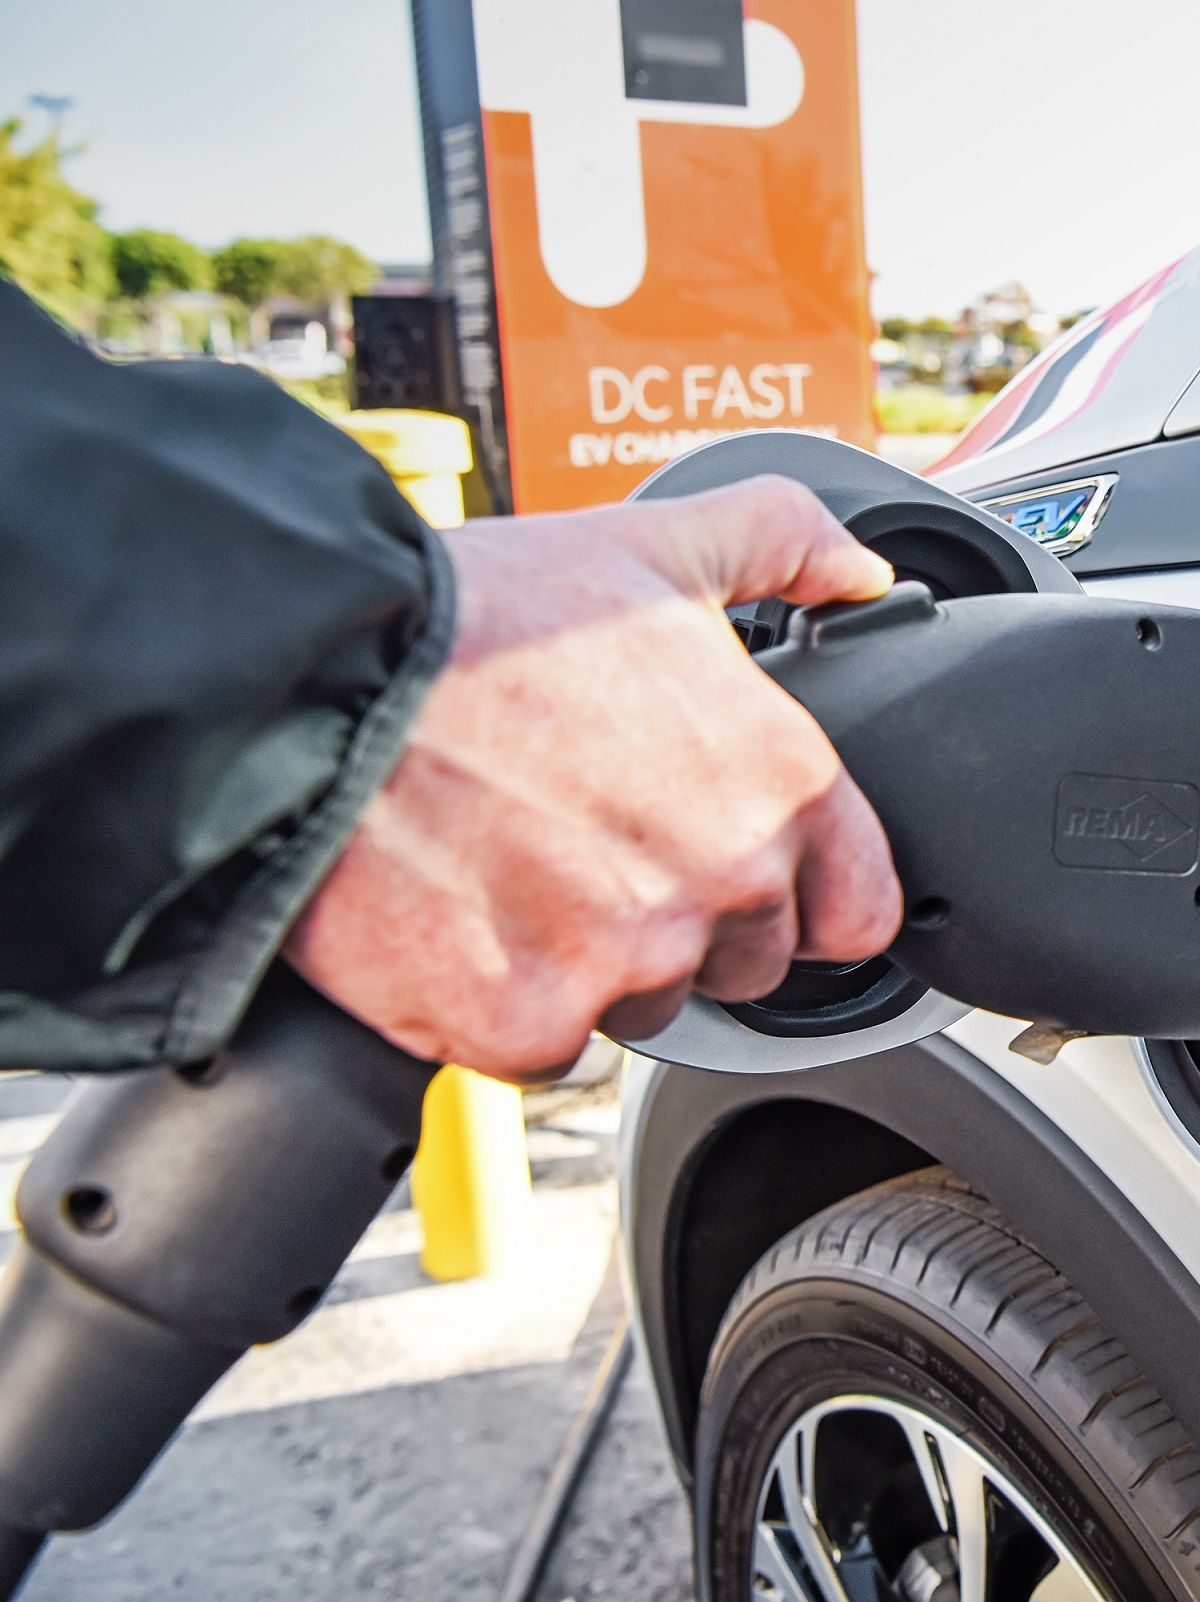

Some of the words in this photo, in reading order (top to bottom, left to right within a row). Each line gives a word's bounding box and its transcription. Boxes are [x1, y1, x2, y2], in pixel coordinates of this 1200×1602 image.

[588, 364, 673, 424] DC
[682, 362, 814, 420] FAST
[569, 432, 612, 467] EV
[1062, 806, 1167, 842] REMA
